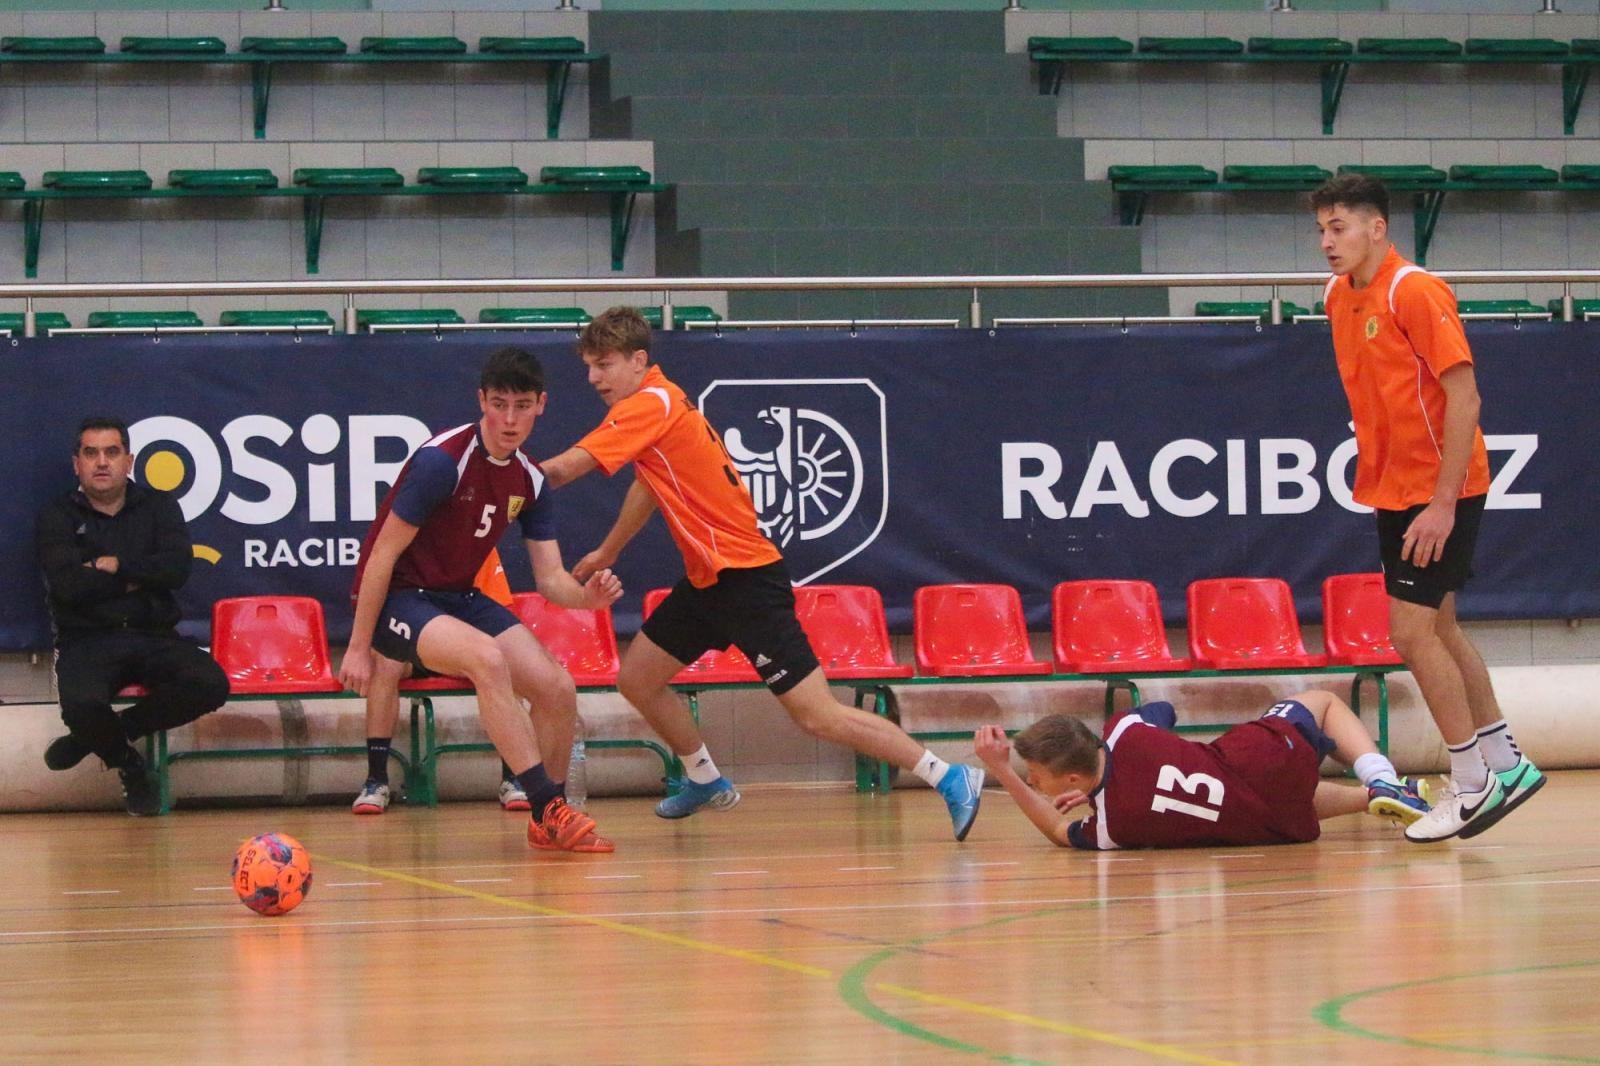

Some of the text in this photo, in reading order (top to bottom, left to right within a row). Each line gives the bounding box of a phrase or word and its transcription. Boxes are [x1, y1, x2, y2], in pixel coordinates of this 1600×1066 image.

[127, 413, 432, 525] OSiR
[1001, 421, 1541, 519] RACIBZ
[473, 504, 497, 538] 5
[244, 538, 361, 568] RACIB
[388, 617, 411, 641] 5
[1151, 764, 1225, 822] 13
[240, 848, 257, 892] SELECT
